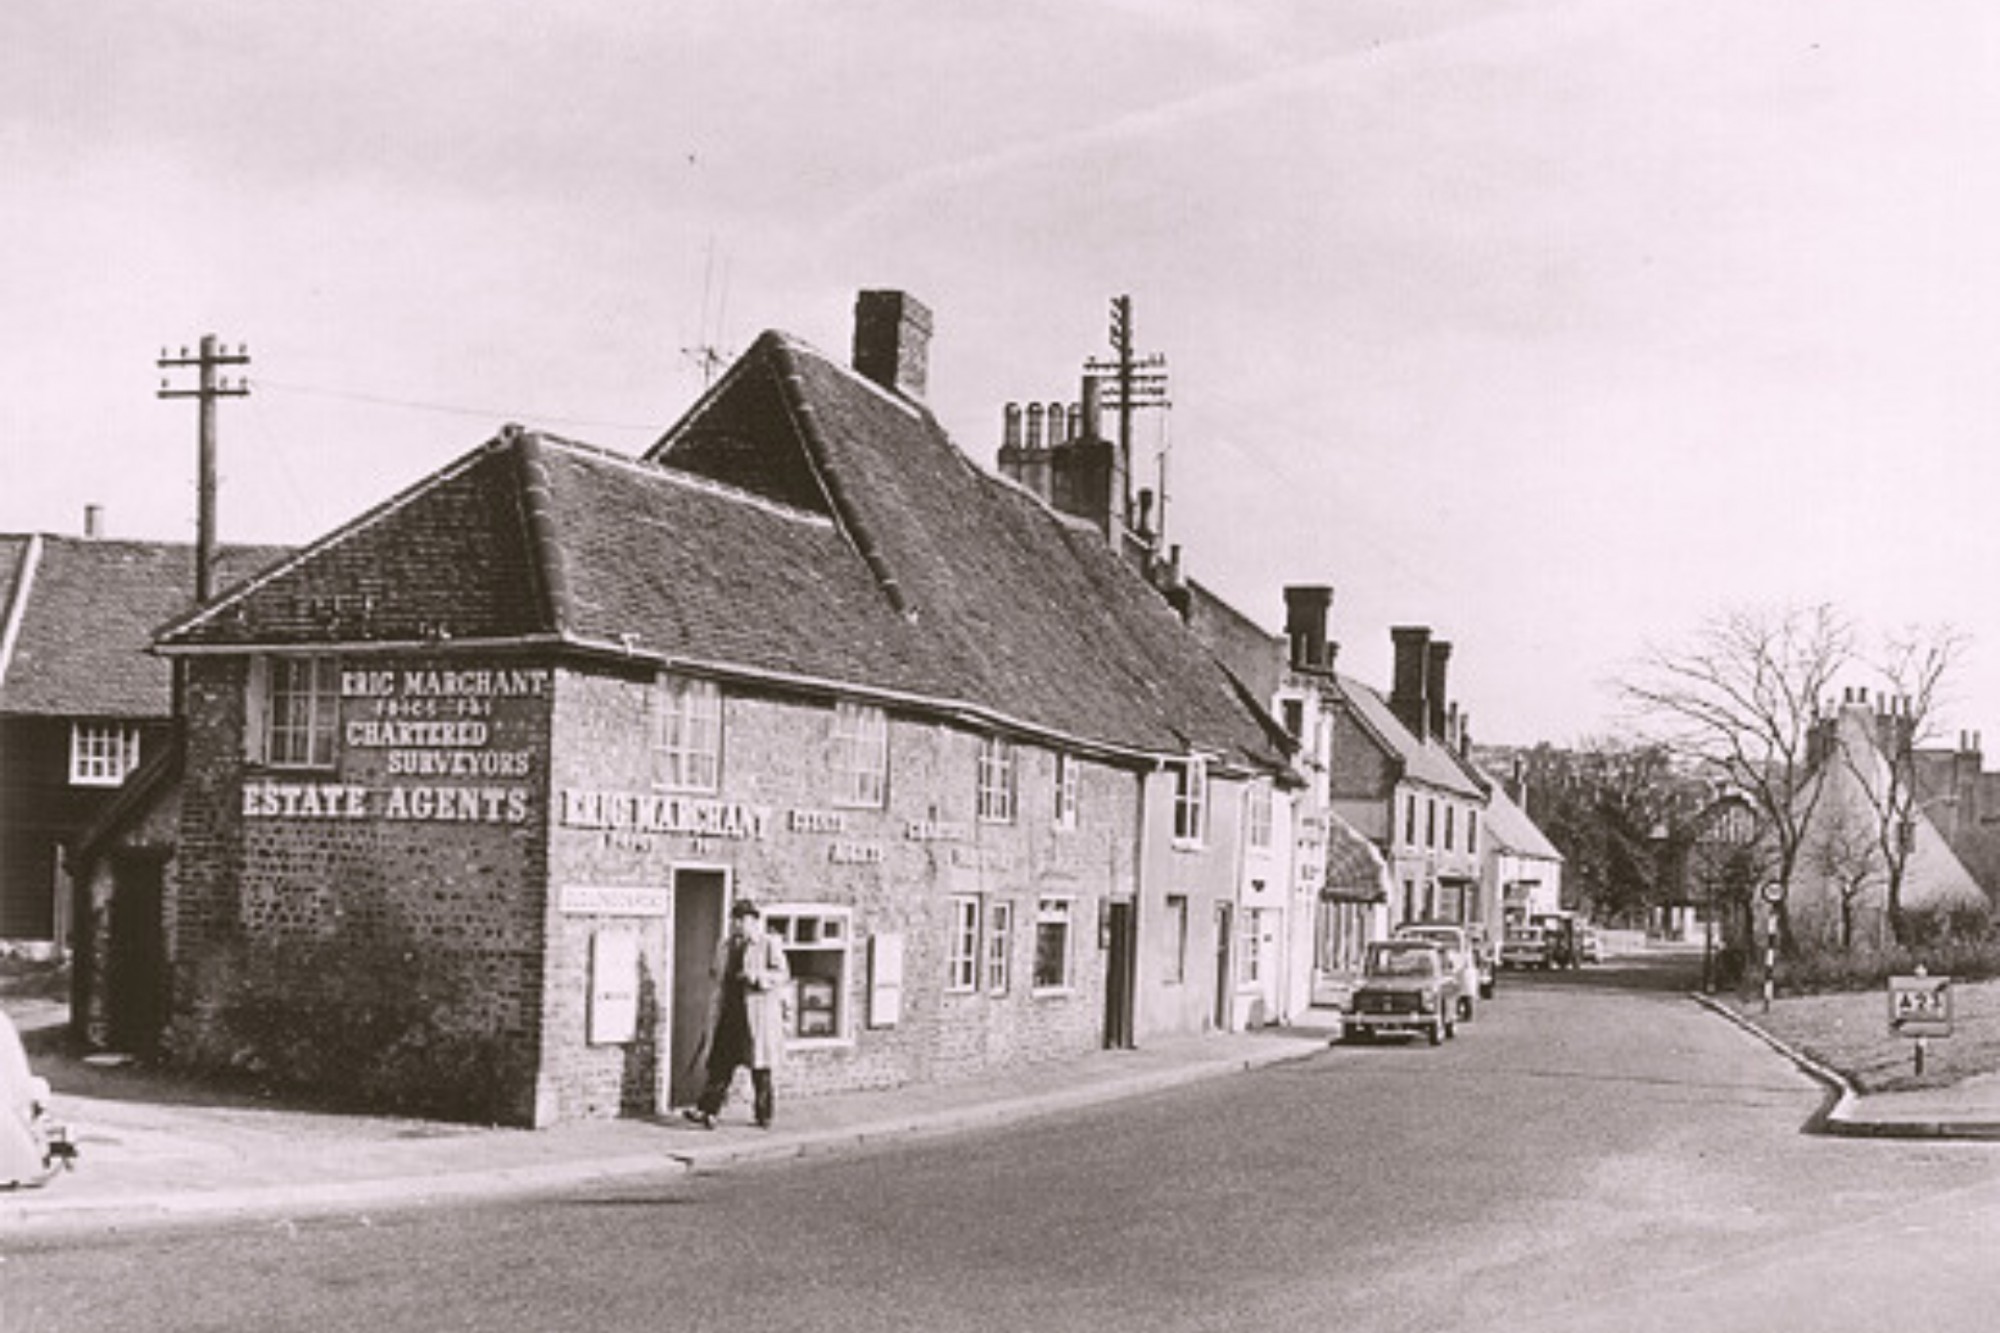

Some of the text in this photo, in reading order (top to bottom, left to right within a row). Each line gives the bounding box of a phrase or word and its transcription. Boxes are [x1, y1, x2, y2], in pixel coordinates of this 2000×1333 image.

[341, 668, 549, 697] ERIC MARCHANT
[346, 721, 488, 747] CHARTERED
[387, 750, 530, 775] SURVEYORS
[242, 783, 528, 821] ESTATE AGENTS
